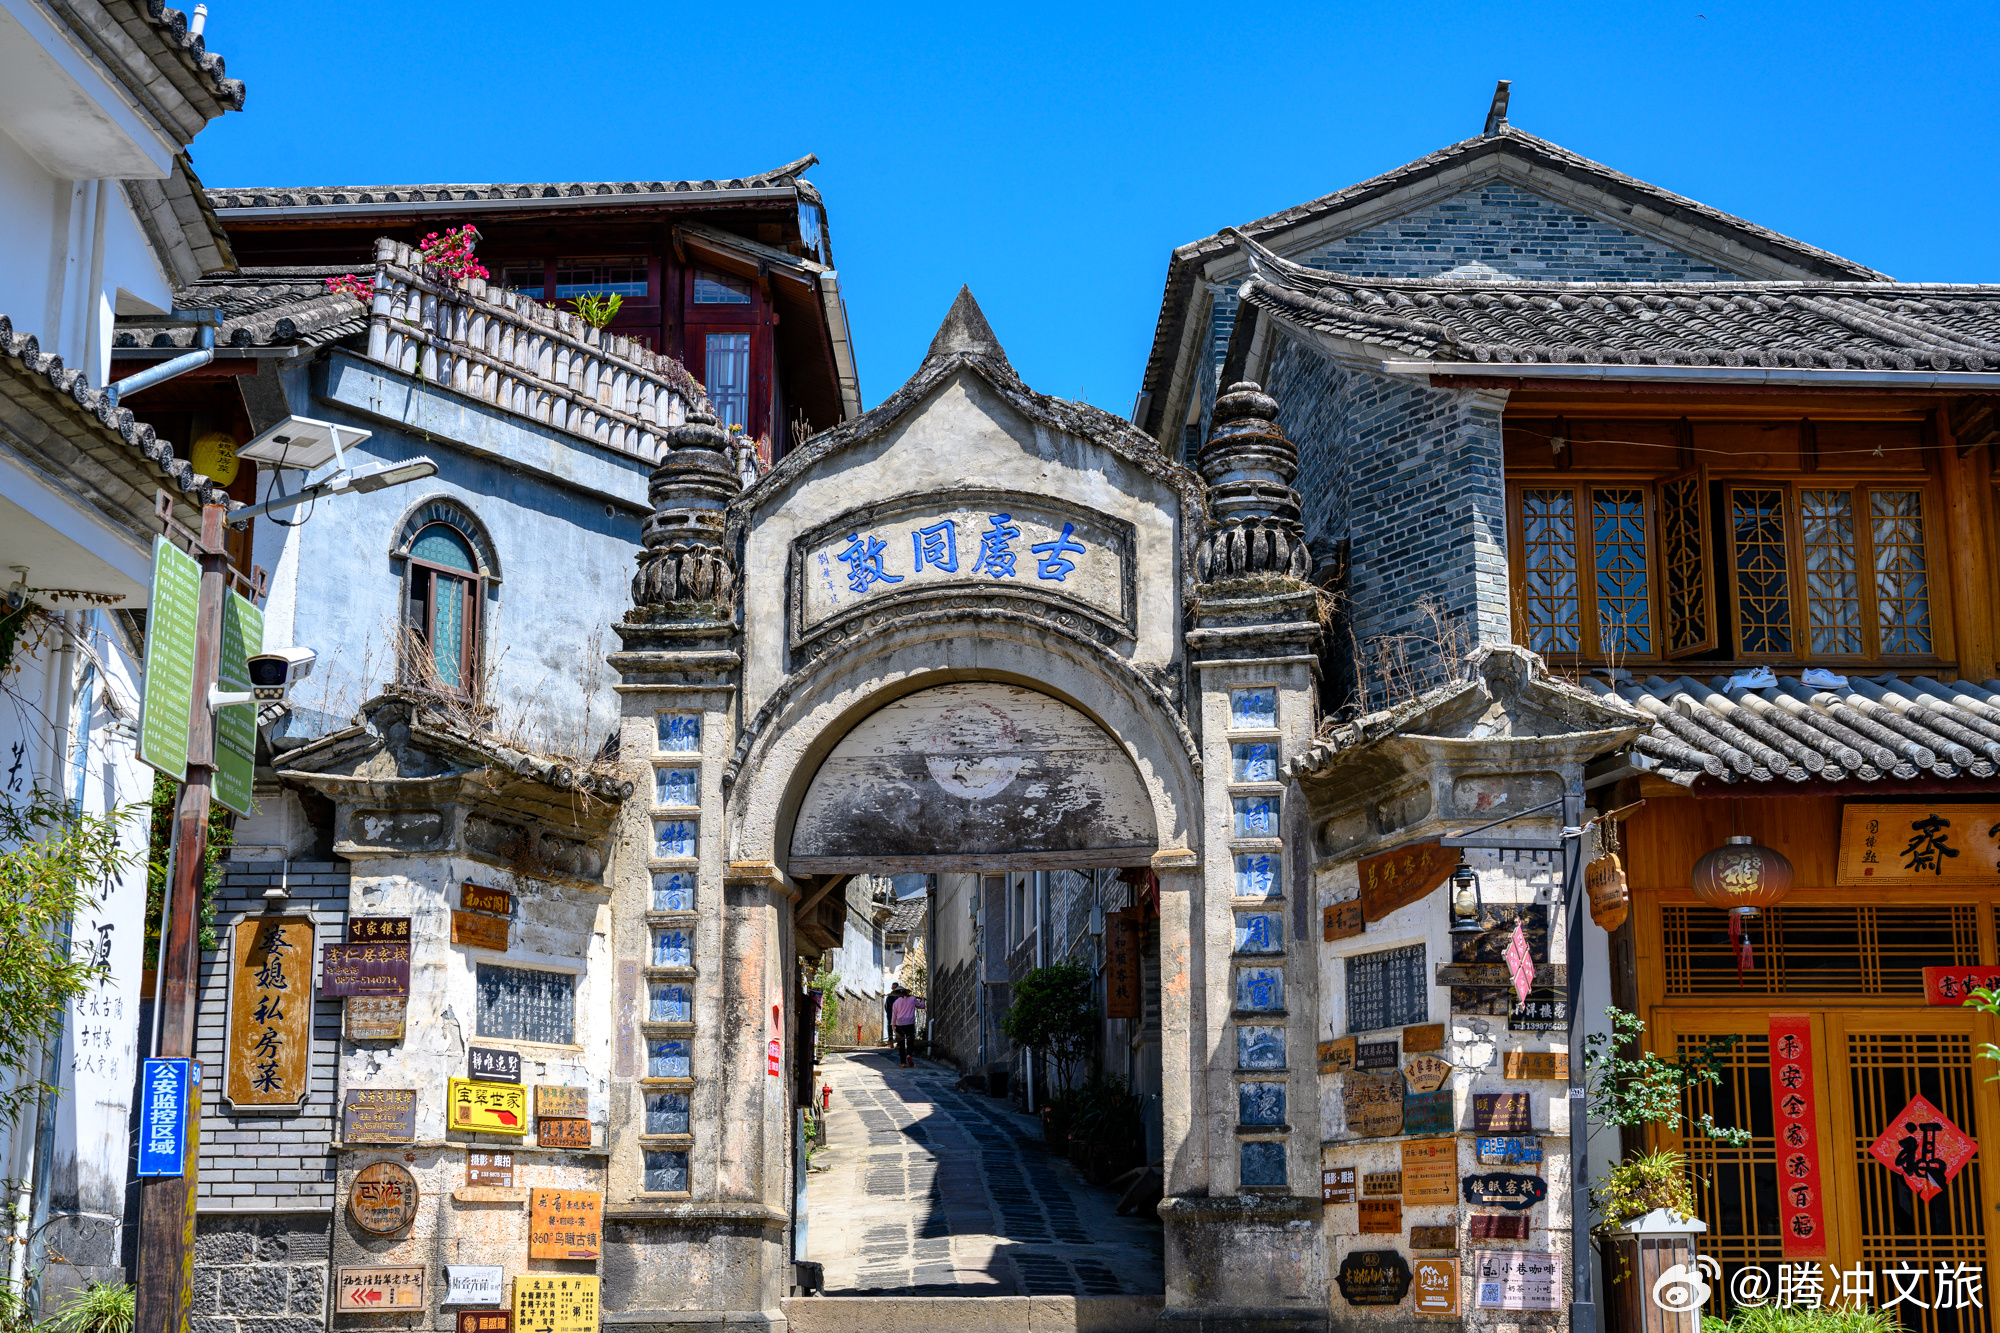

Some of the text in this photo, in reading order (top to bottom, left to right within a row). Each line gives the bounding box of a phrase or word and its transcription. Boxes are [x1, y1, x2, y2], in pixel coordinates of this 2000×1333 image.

[335, 976, 398, 984] 0875-5140714
[253, 926, 294, 1094] 婆媳私房菜
[192, 1066, 200, 1083] 50
[457, 1087, 521, 1109] 宝翠世家
[148, 1063, 178, 1155] 公安监控区域
[1778, 1033, 1814, 1241] 平安全家添百福
[532, 1231, 597, 1247] 360°鸟瞰古镇
[1502, 1262, 1556, 1276] 小巷咖啡
[533, 1281, 581, 1289] 北京餐厅
[1507, 1284, 1551, 1294] 奶茶·小吃
[572, 1305, 581, 1319] 粥
